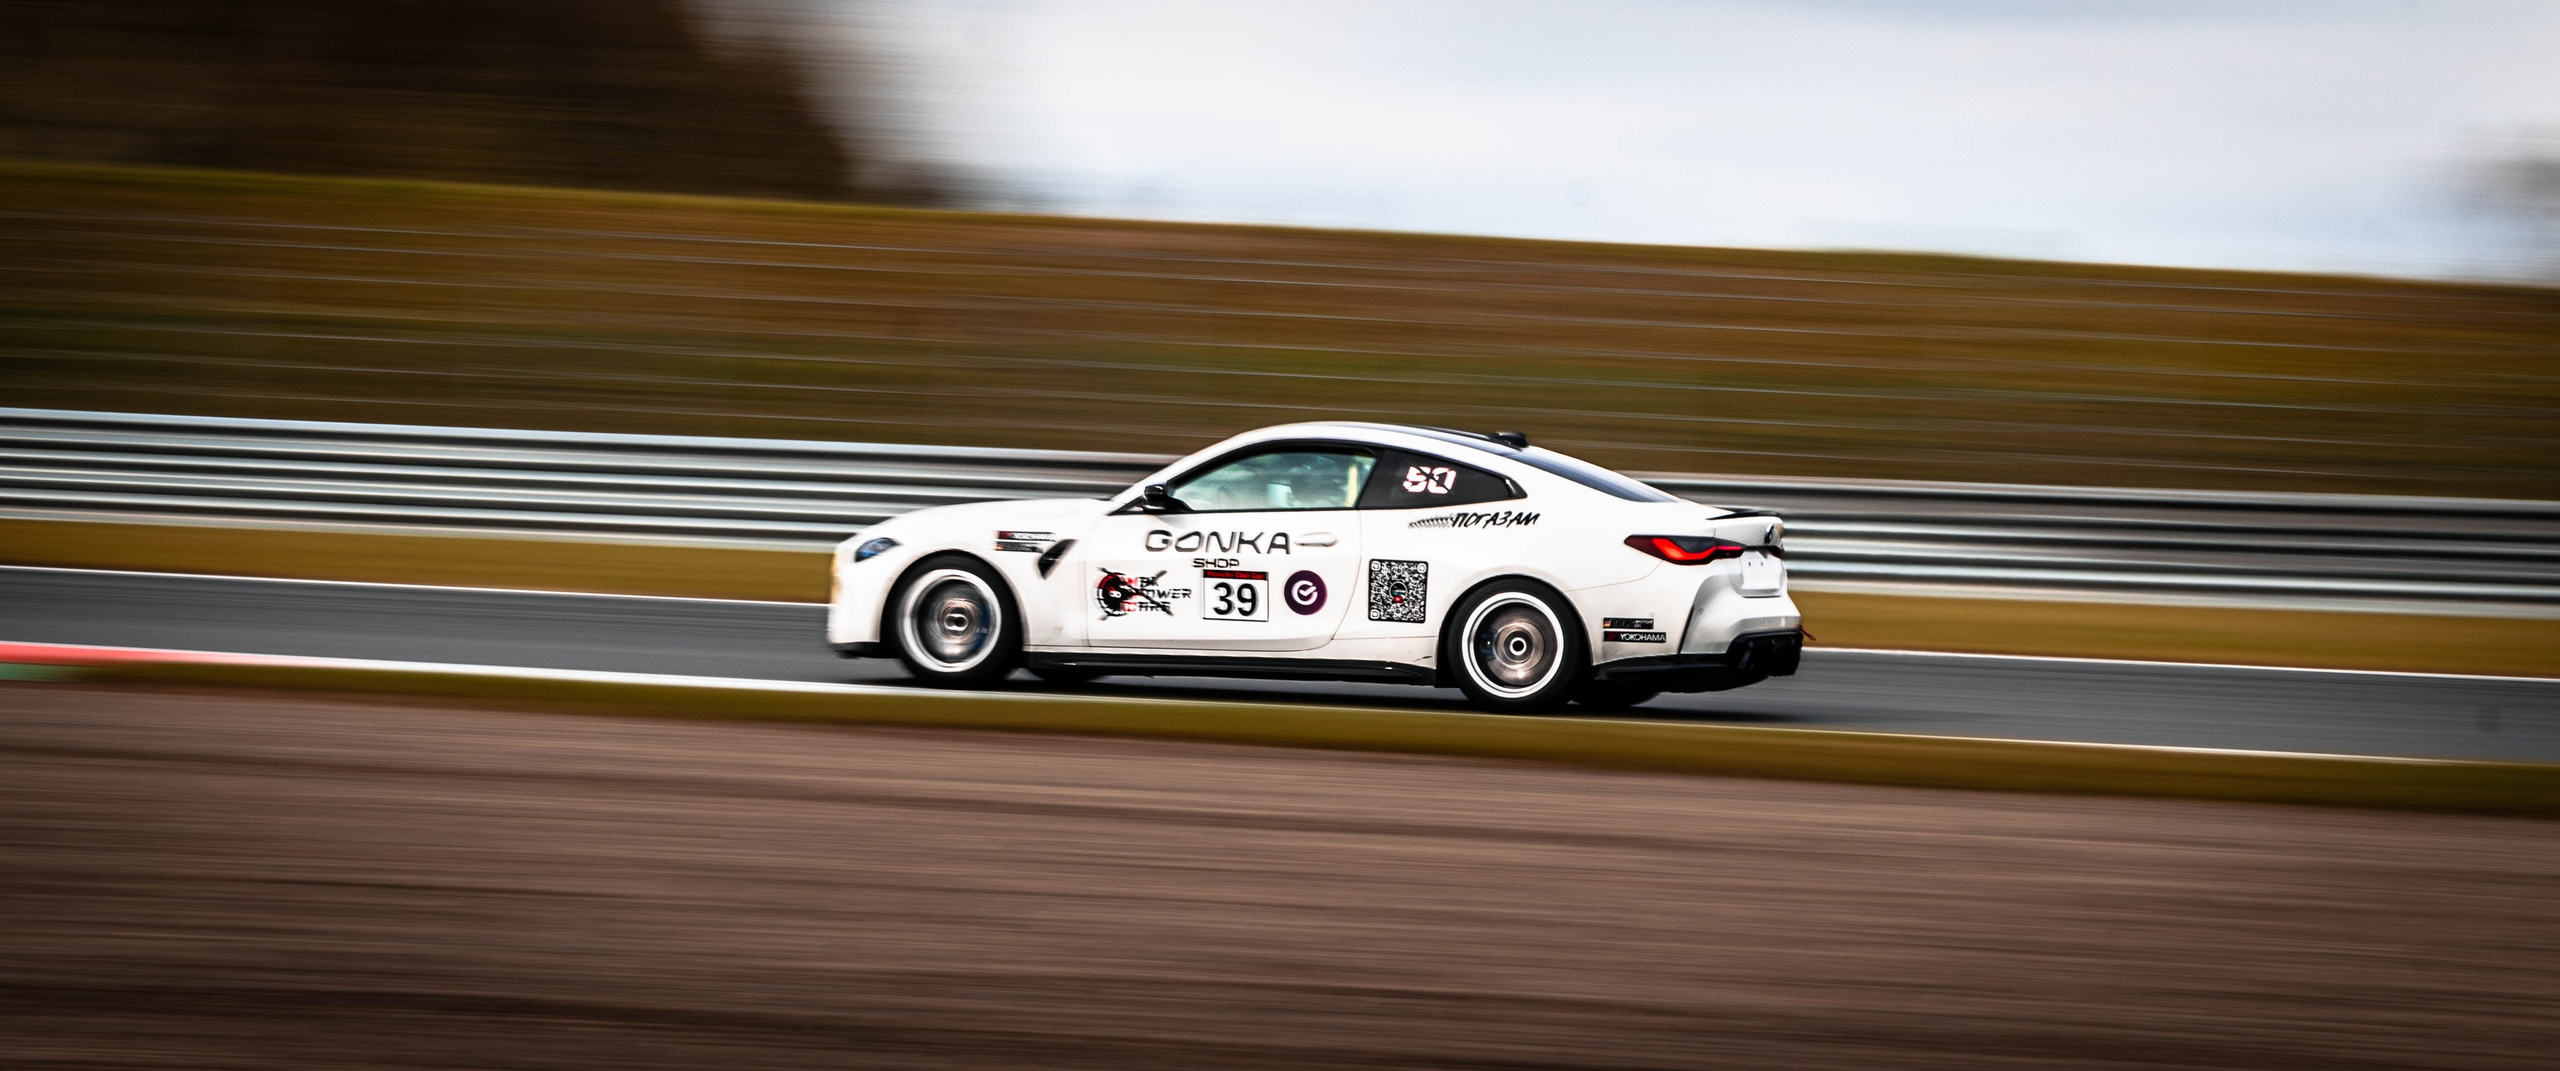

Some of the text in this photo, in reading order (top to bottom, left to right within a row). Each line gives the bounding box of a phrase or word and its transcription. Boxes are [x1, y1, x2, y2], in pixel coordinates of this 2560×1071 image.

[1145, 529, 1291, 555] GONKA
[1192, 558, 1239, 568] SHOP
[1213, 582, 1260, 616] 39
[1620, 633, 1665, 641] YOKOHAMA
